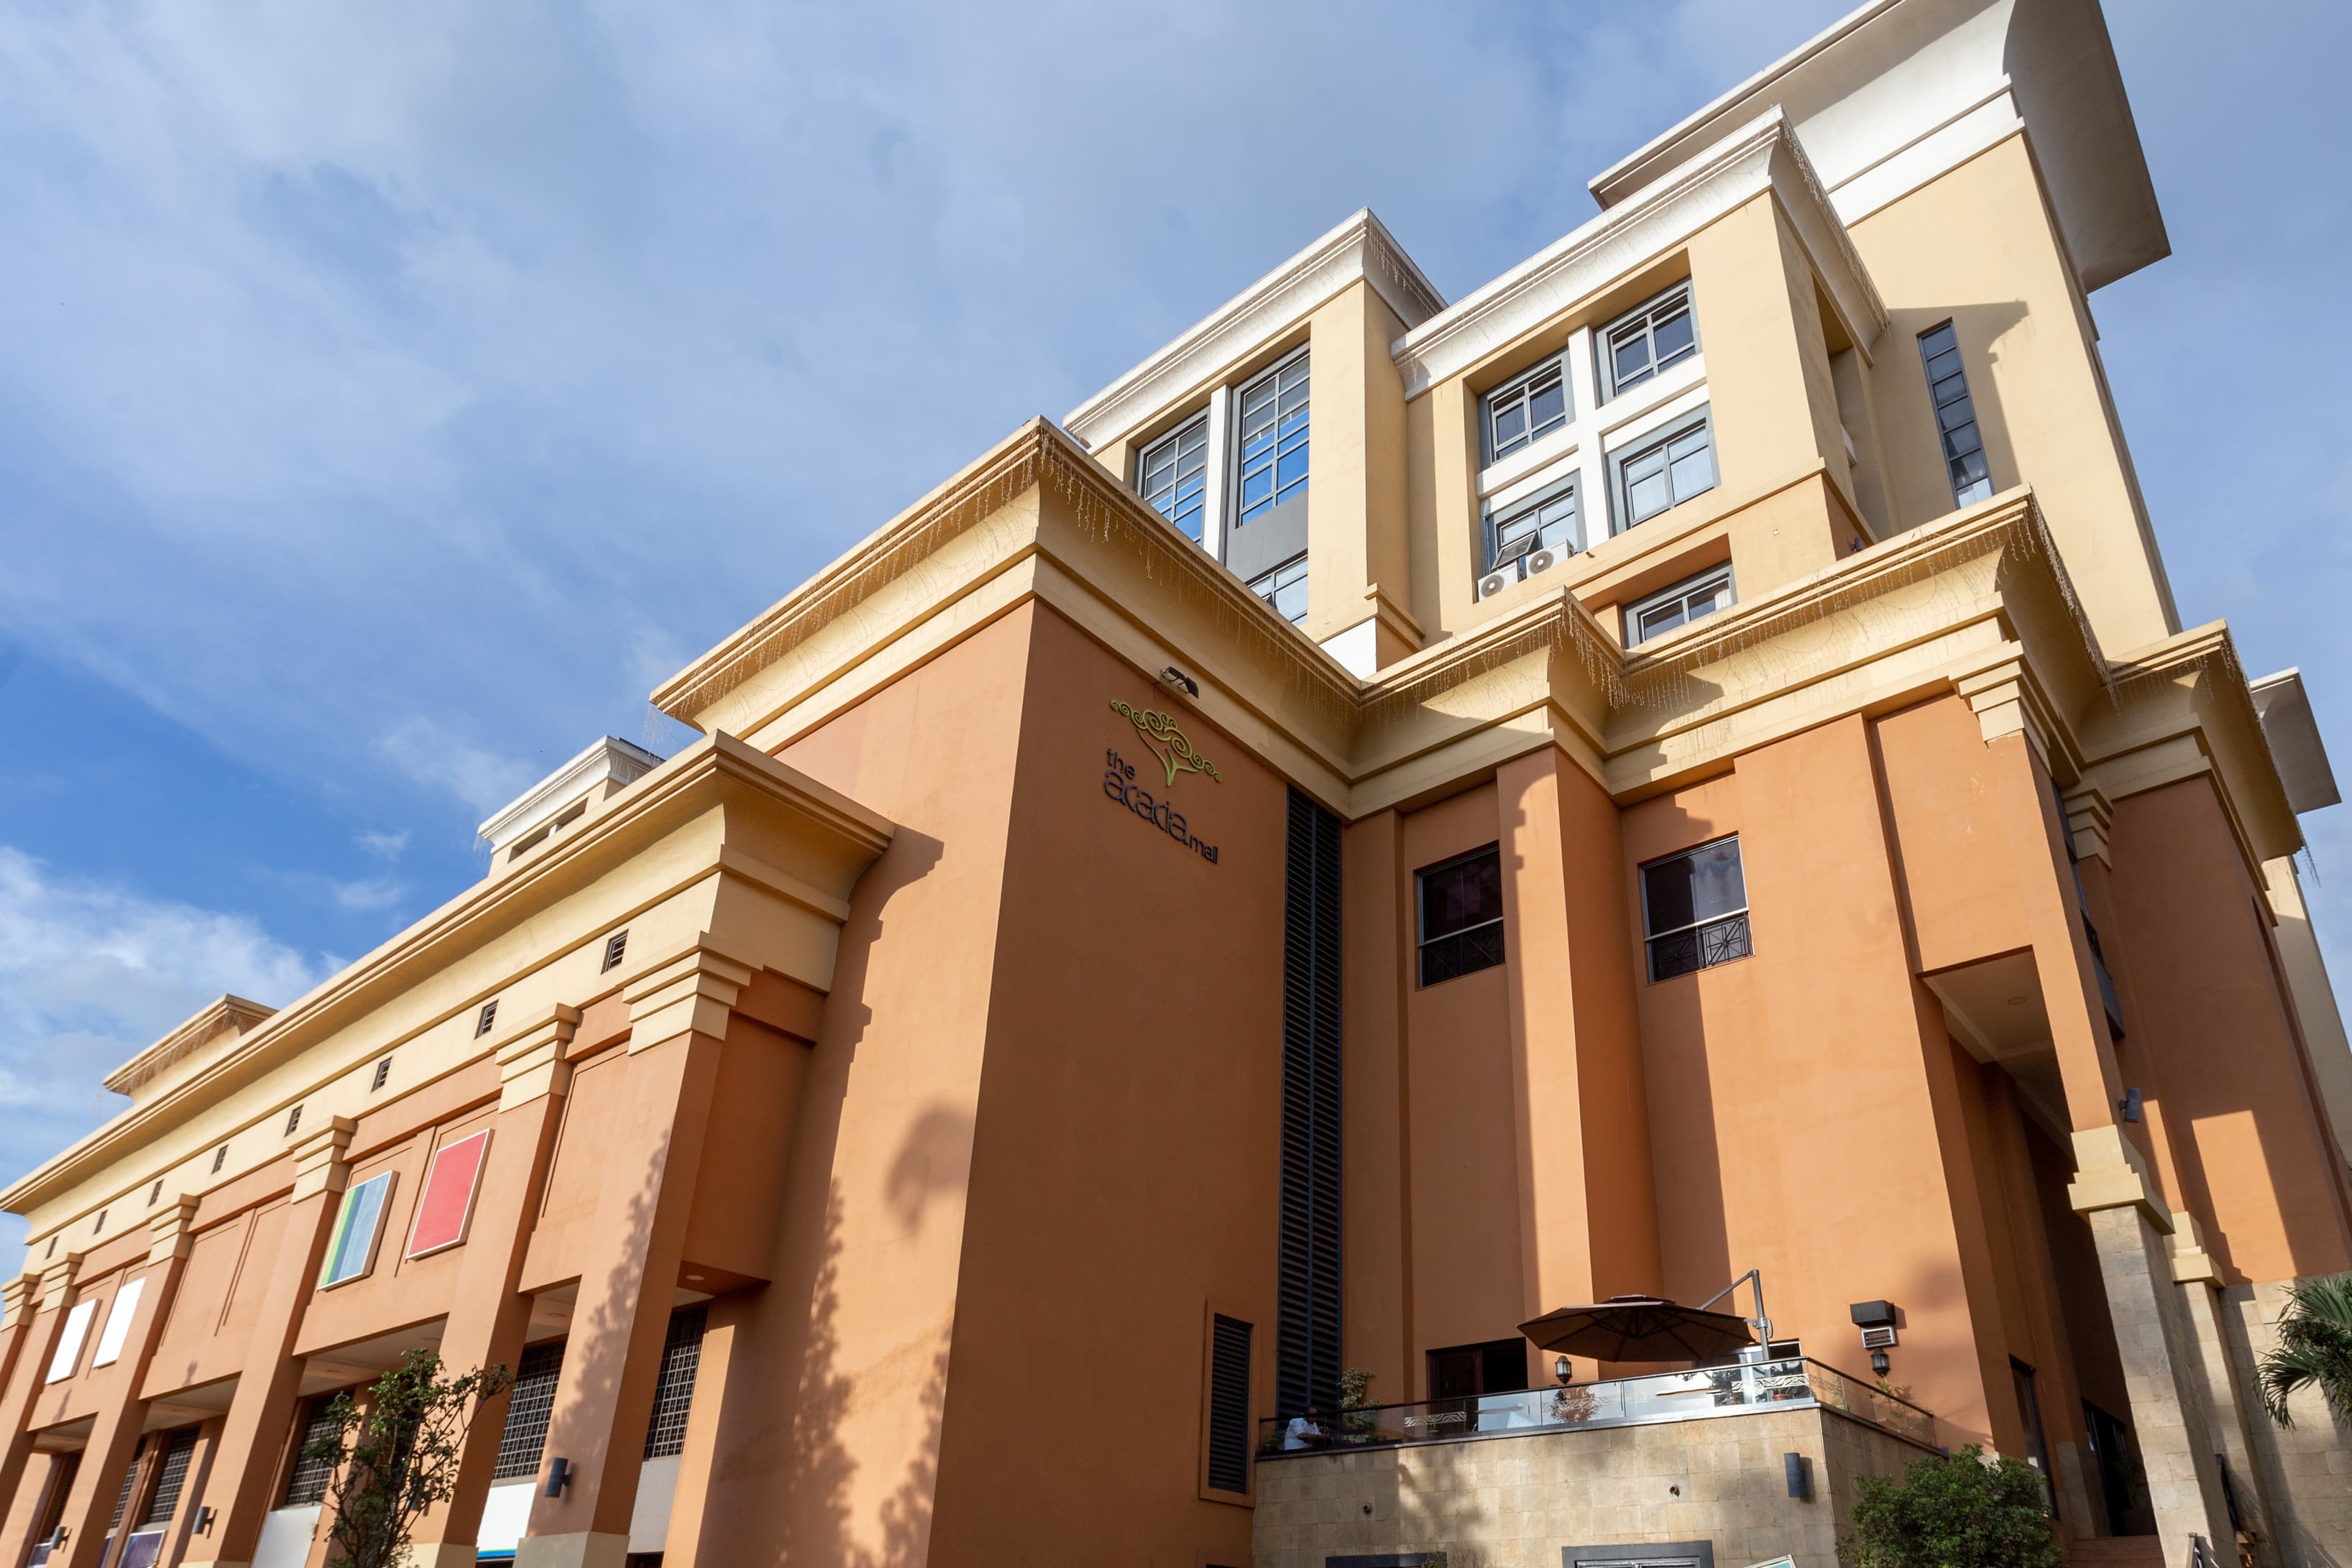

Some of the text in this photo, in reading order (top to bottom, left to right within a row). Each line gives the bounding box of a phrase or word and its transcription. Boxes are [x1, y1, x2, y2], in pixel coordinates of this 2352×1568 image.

[1106, 748, 1136, 780] the
[1104, 770, 1219, 864] acacia mall
